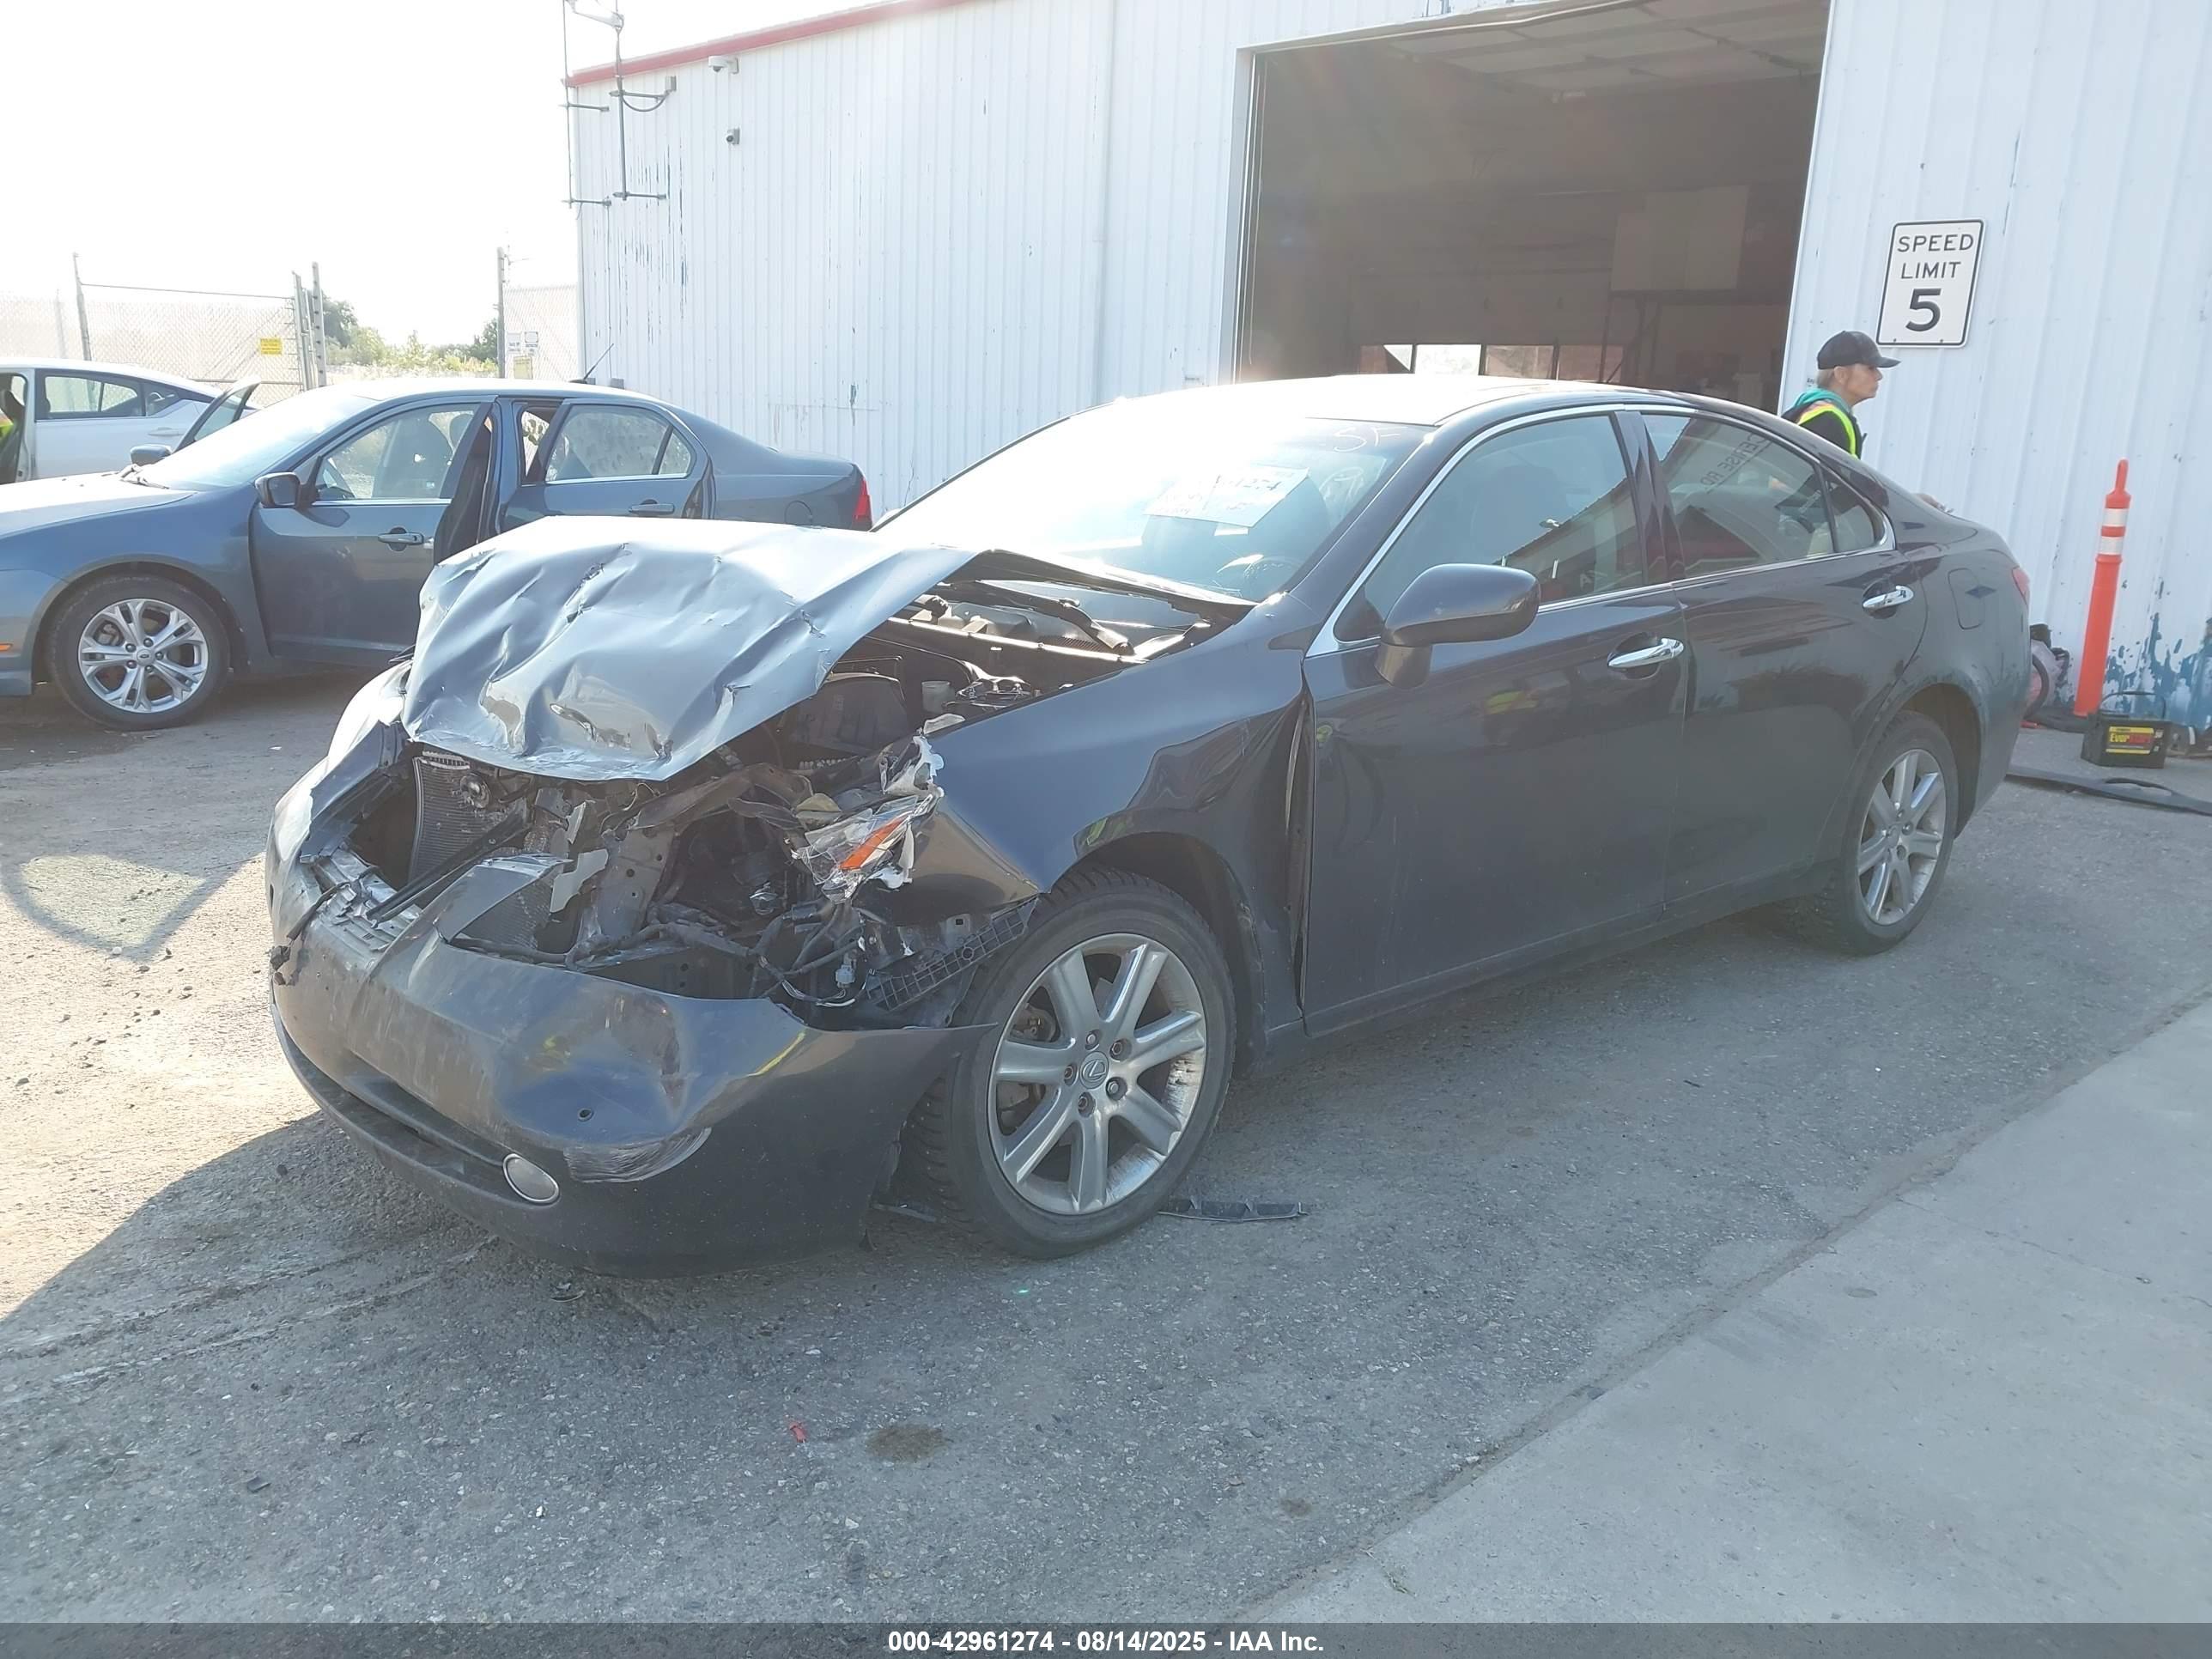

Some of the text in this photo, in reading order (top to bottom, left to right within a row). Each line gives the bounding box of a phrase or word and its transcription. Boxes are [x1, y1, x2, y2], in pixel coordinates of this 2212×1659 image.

[1897, 234, 1974, 252] SPEED
[1900, 261, 1961, 280] LIMIT
[1905, 288, 1942, 332] 5
